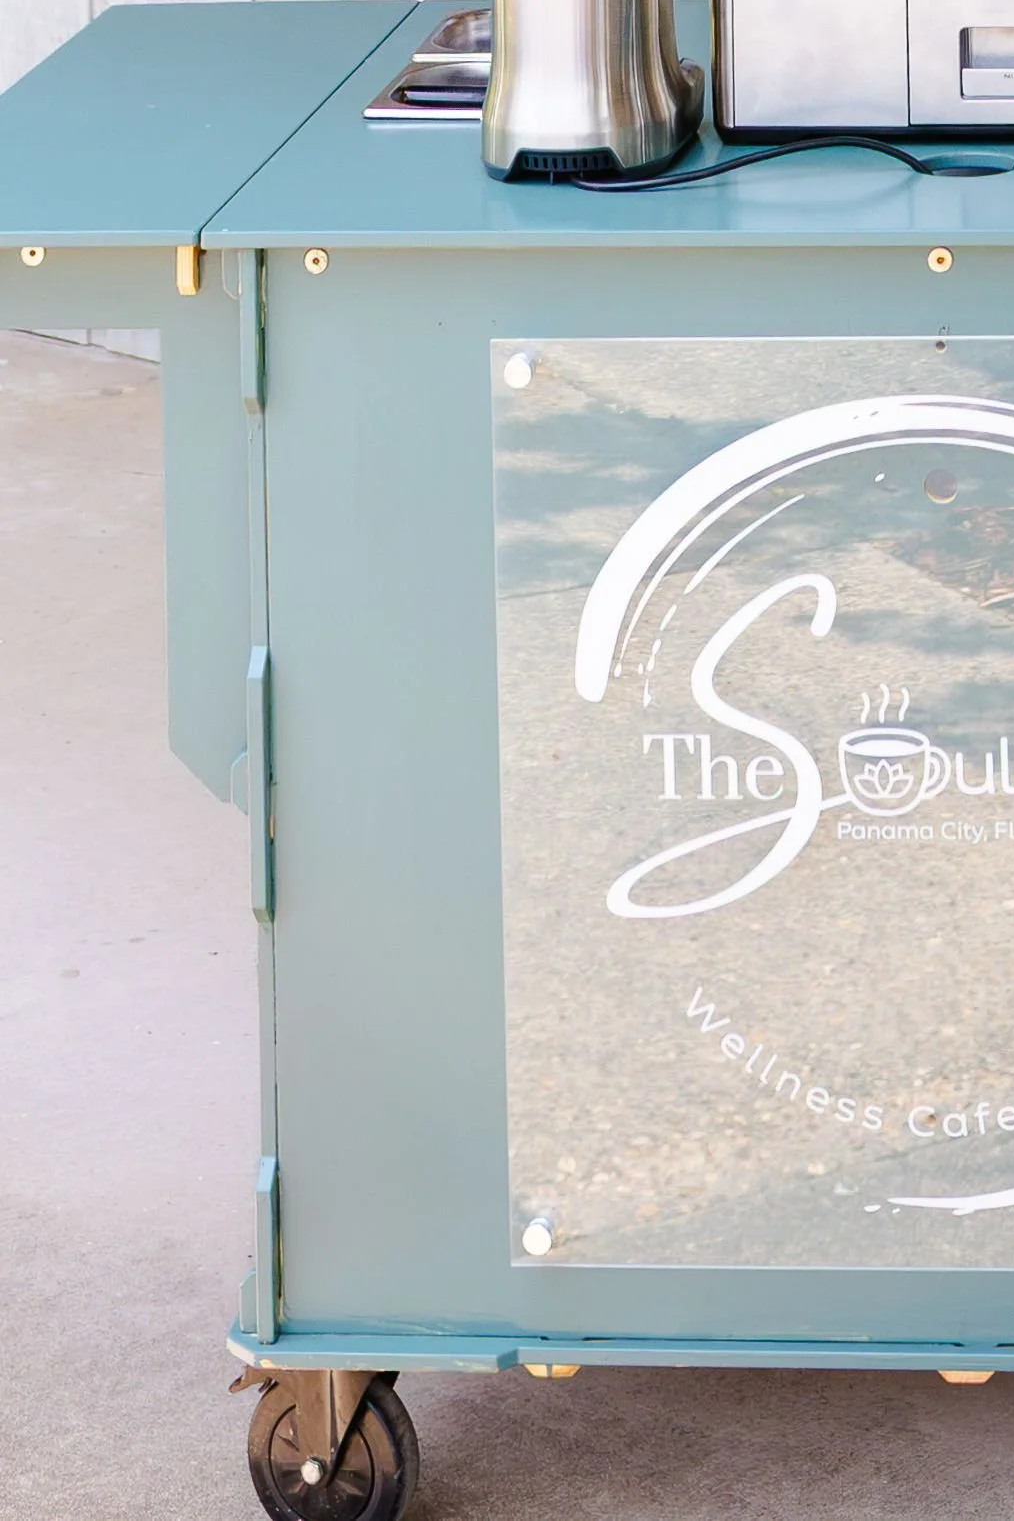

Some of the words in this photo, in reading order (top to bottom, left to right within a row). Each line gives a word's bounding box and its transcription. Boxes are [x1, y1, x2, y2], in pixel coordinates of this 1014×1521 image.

[643, 734, 785, 800] The
[837, 820, 934, 840] Panama
[941, 820, 988, 845] City,
[685, 986, 884, 1132] Wellness
